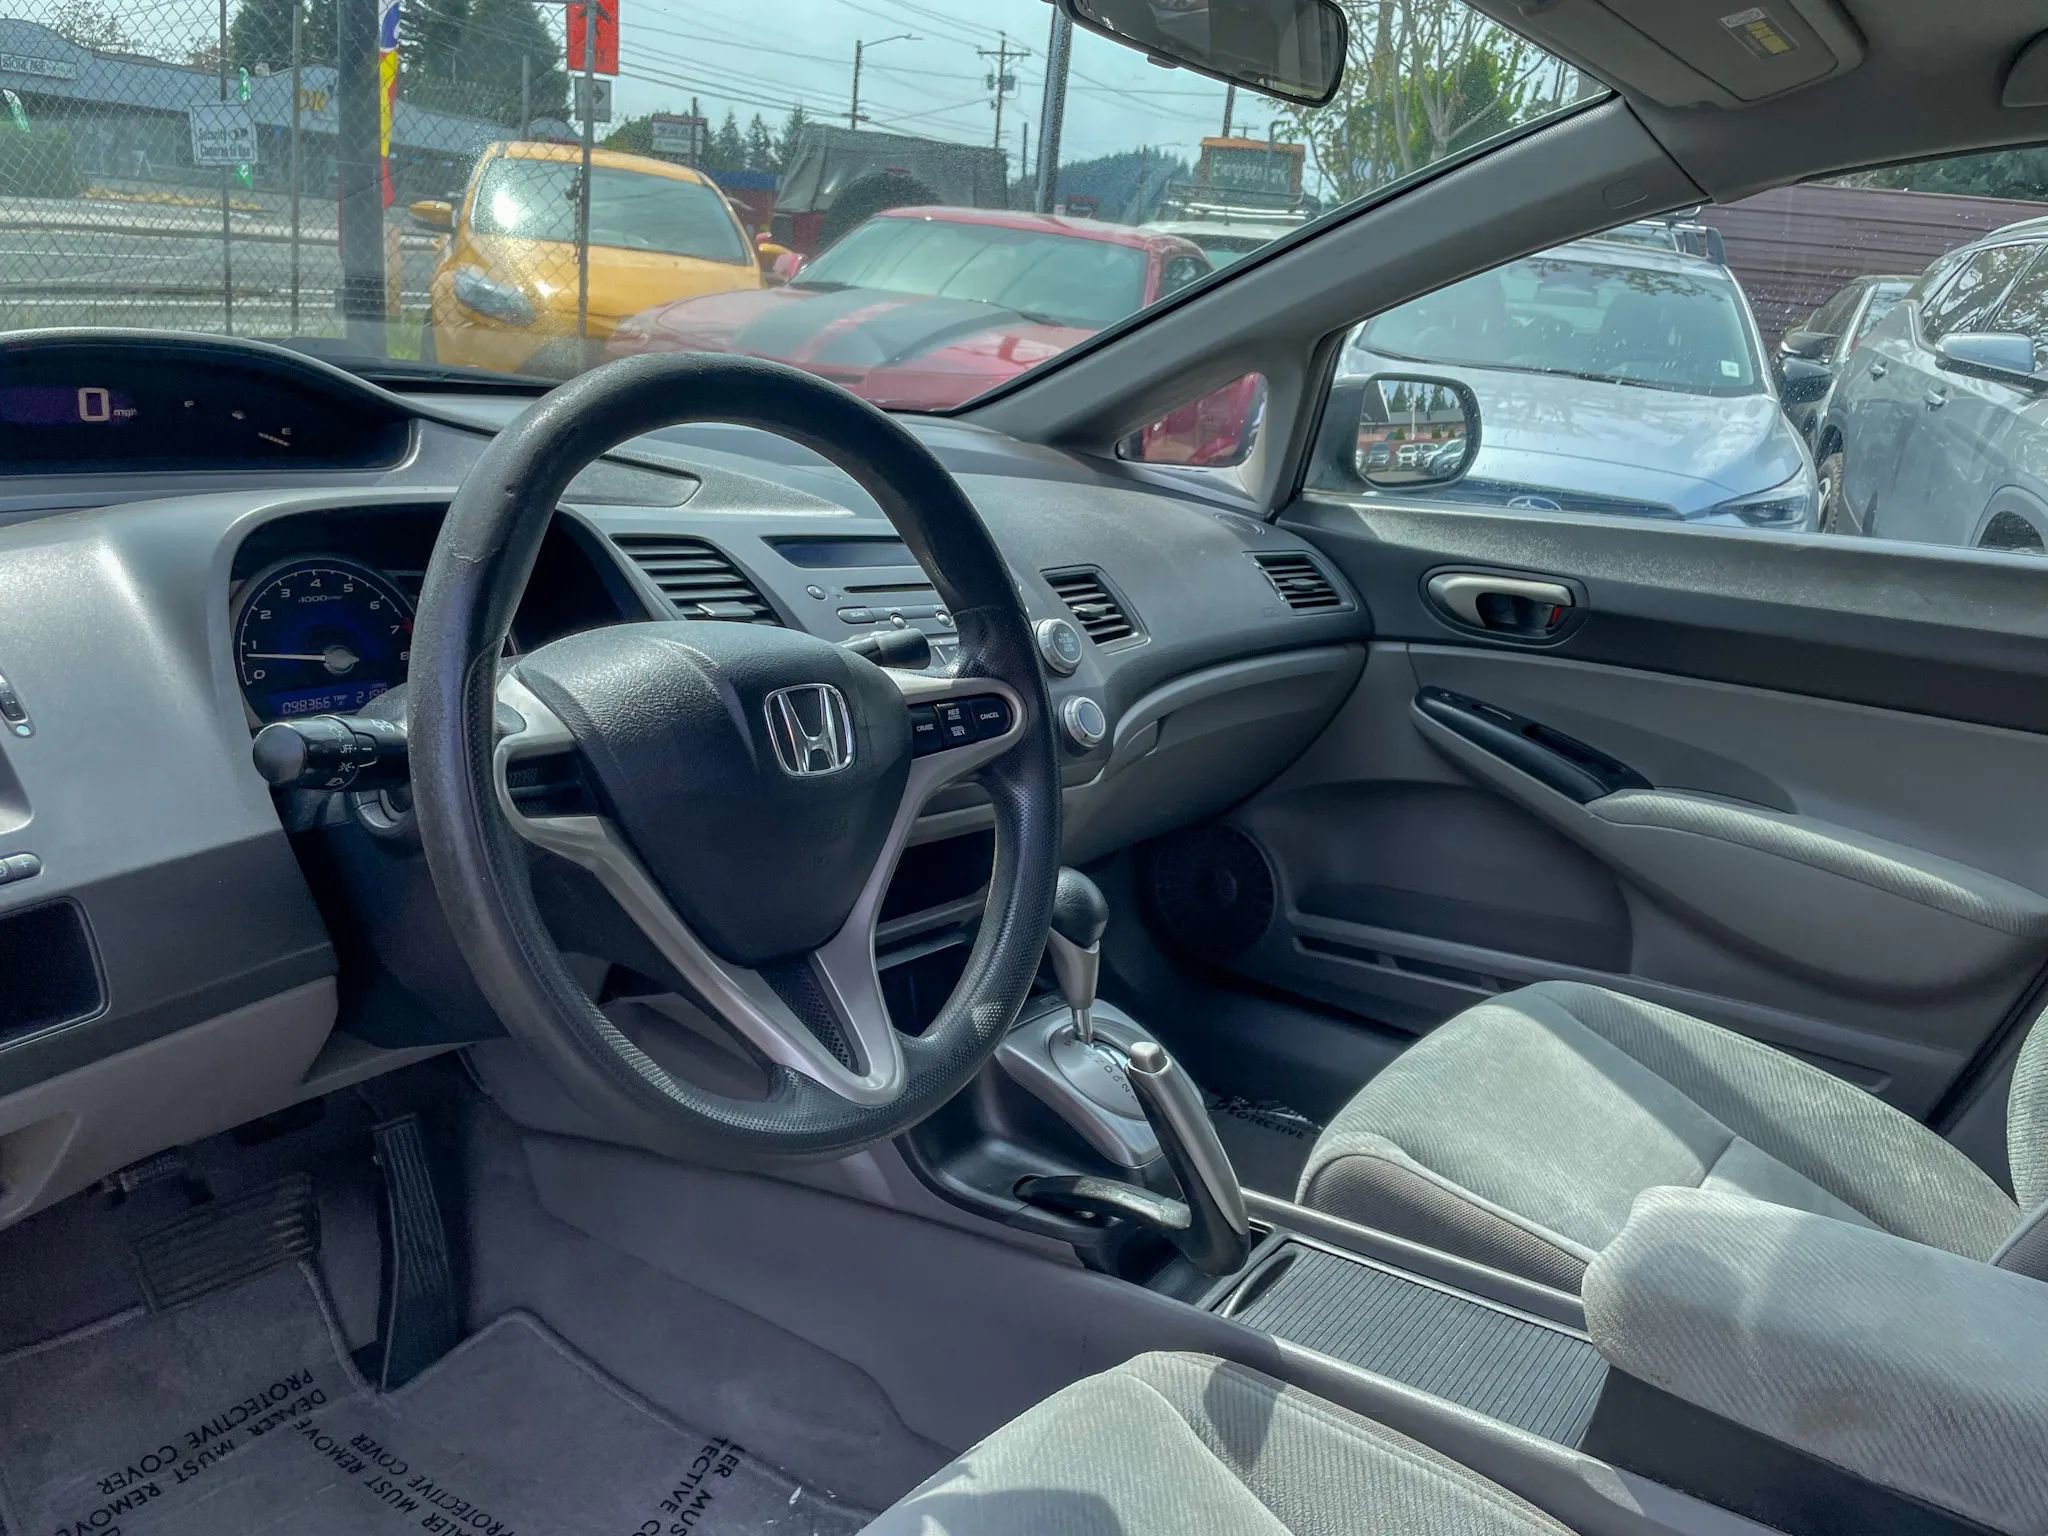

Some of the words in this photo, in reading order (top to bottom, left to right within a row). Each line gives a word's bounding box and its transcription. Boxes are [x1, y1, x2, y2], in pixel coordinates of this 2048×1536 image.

[78, 387, 110, 421] 0
[310, 578, 321, 588] 4
[343, 583, 354, 593] 5
[280, 588, 291, 598] 3
[369, 600, 380, 610] 6
[260, 610, 272, 620] 2
[389, 625, 400, 635] 7
[251, 640, 258, 650] 1
[253, 669, 266, 680] 0
[282, 697, 331, 714] 098366
[980, 711, 1000, 721] CANCEL
[184, 1368, 315, 1449] PROTECTIVE
[350, 1432, 409, 1476] COVER
[96, 1444, 179, 1496] COVER
[363, 1475, 420, 1515] MUST
